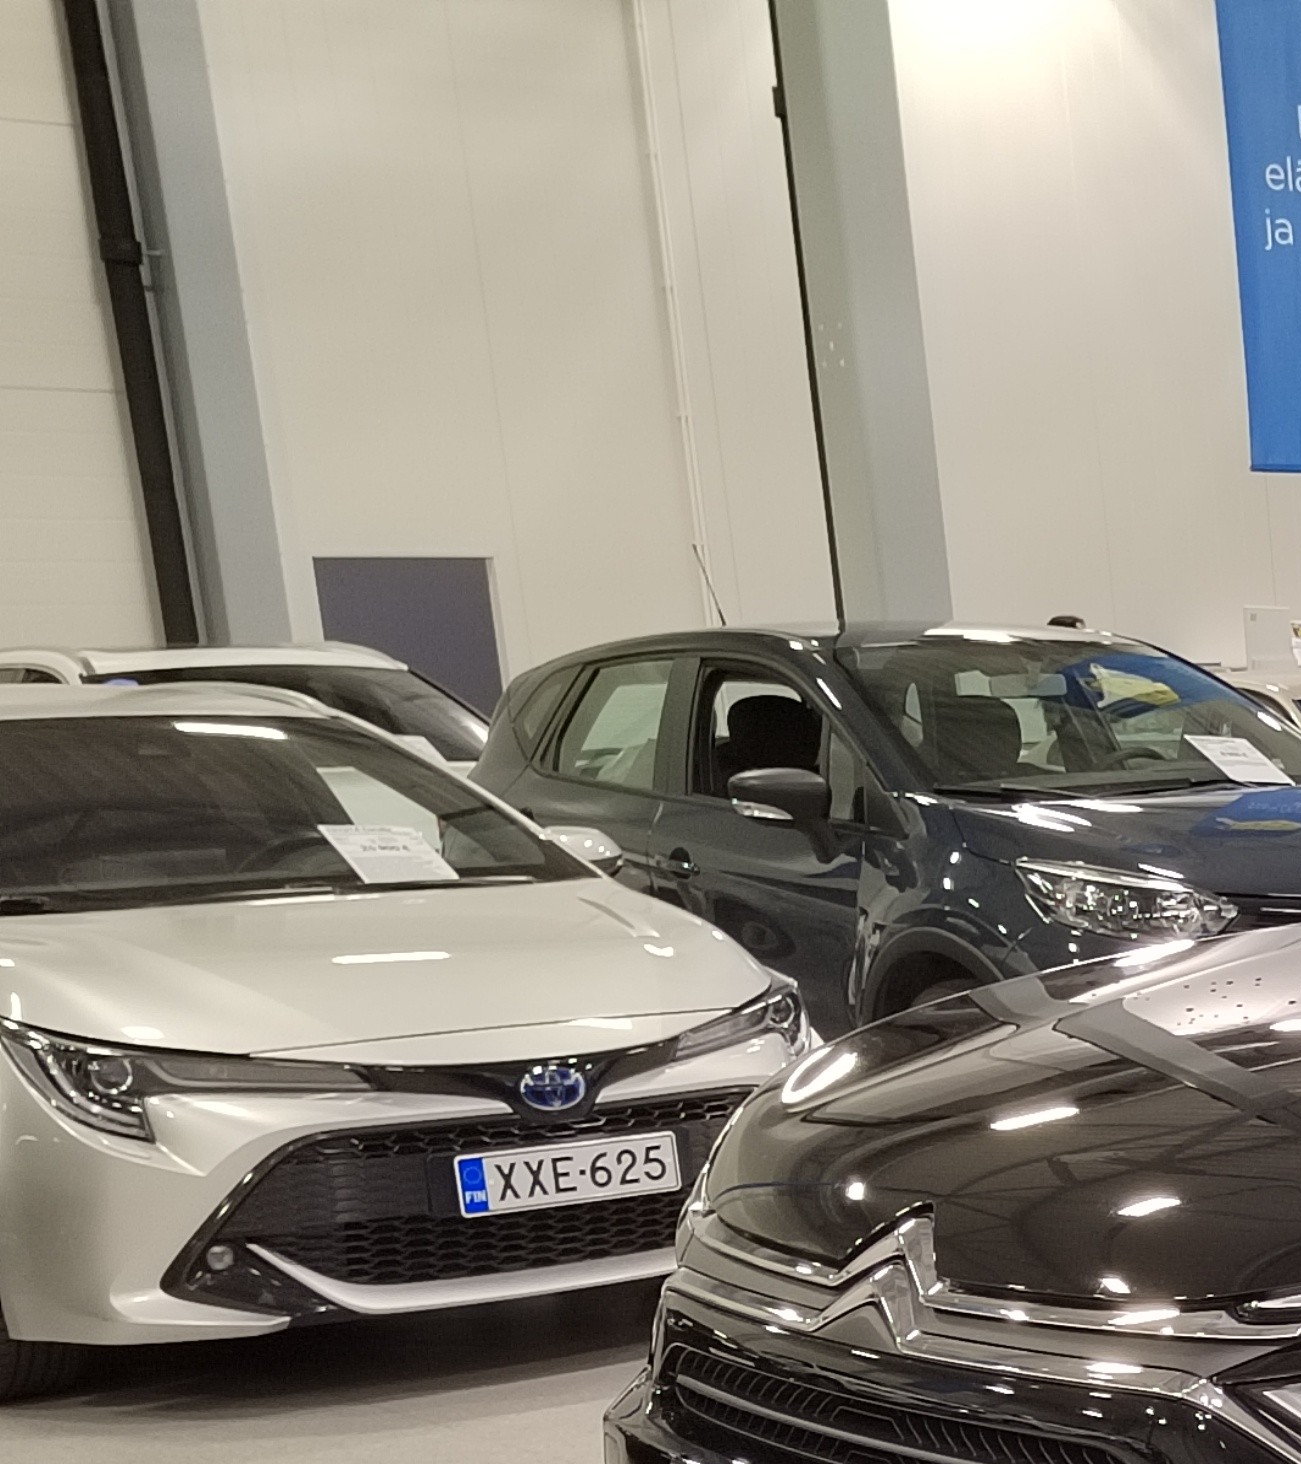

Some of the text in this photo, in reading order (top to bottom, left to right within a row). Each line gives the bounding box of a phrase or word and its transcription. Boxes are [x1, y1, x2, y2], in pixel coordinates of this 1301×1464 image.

[1263, 213, 1297, 253] ja
[494, 1144, 669, 1202] XXE-625
[464, 1189, 488, 1207] FIN
